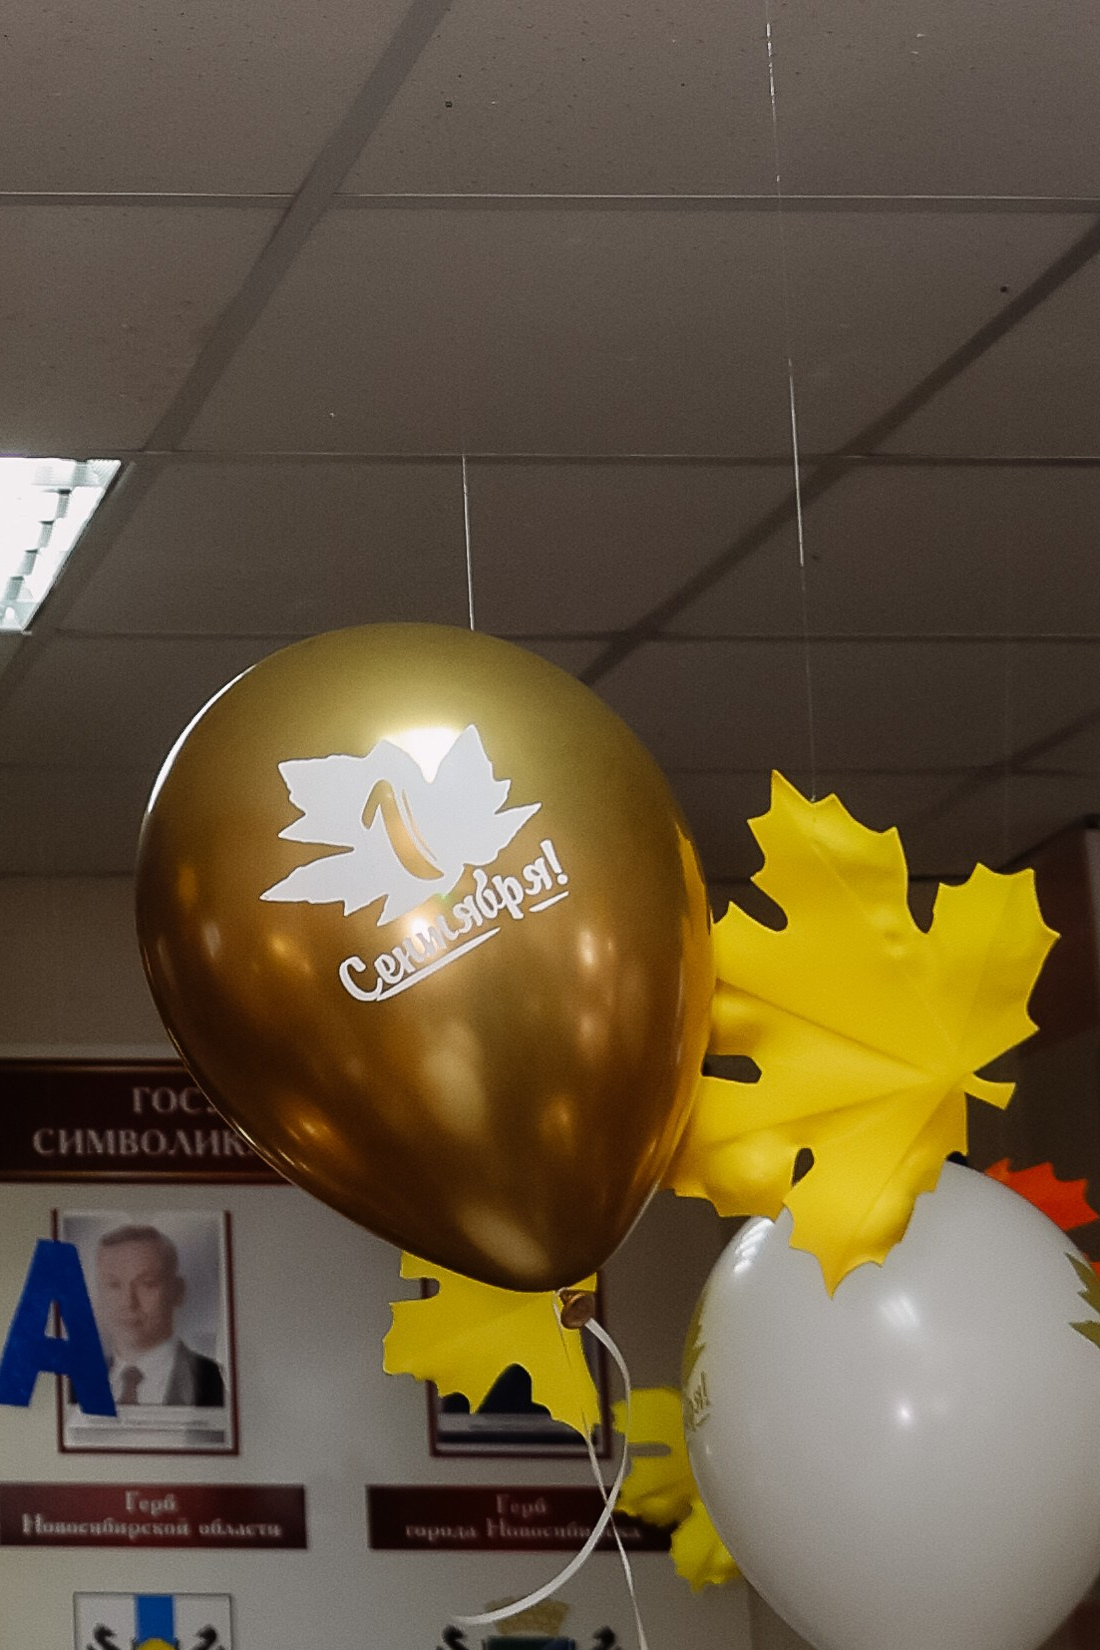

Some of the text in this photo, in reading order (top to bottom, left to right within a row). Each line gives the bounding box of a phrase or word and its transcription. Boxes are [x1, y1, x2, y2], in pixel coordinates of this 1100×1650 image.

[338, 838, 569, 1001] Сентября!
[131, 1085, 215, 1115] ГОС
[32, 1127, 253, 1158] СИМВОЛИК
[124, 1490, 178, 1516] Герб
[496, 1493, 548, 1518] Герб
[21, 1513, 282, 1541] Новосибирской области
[484, 1517, 642, 1539] Новосибиска
